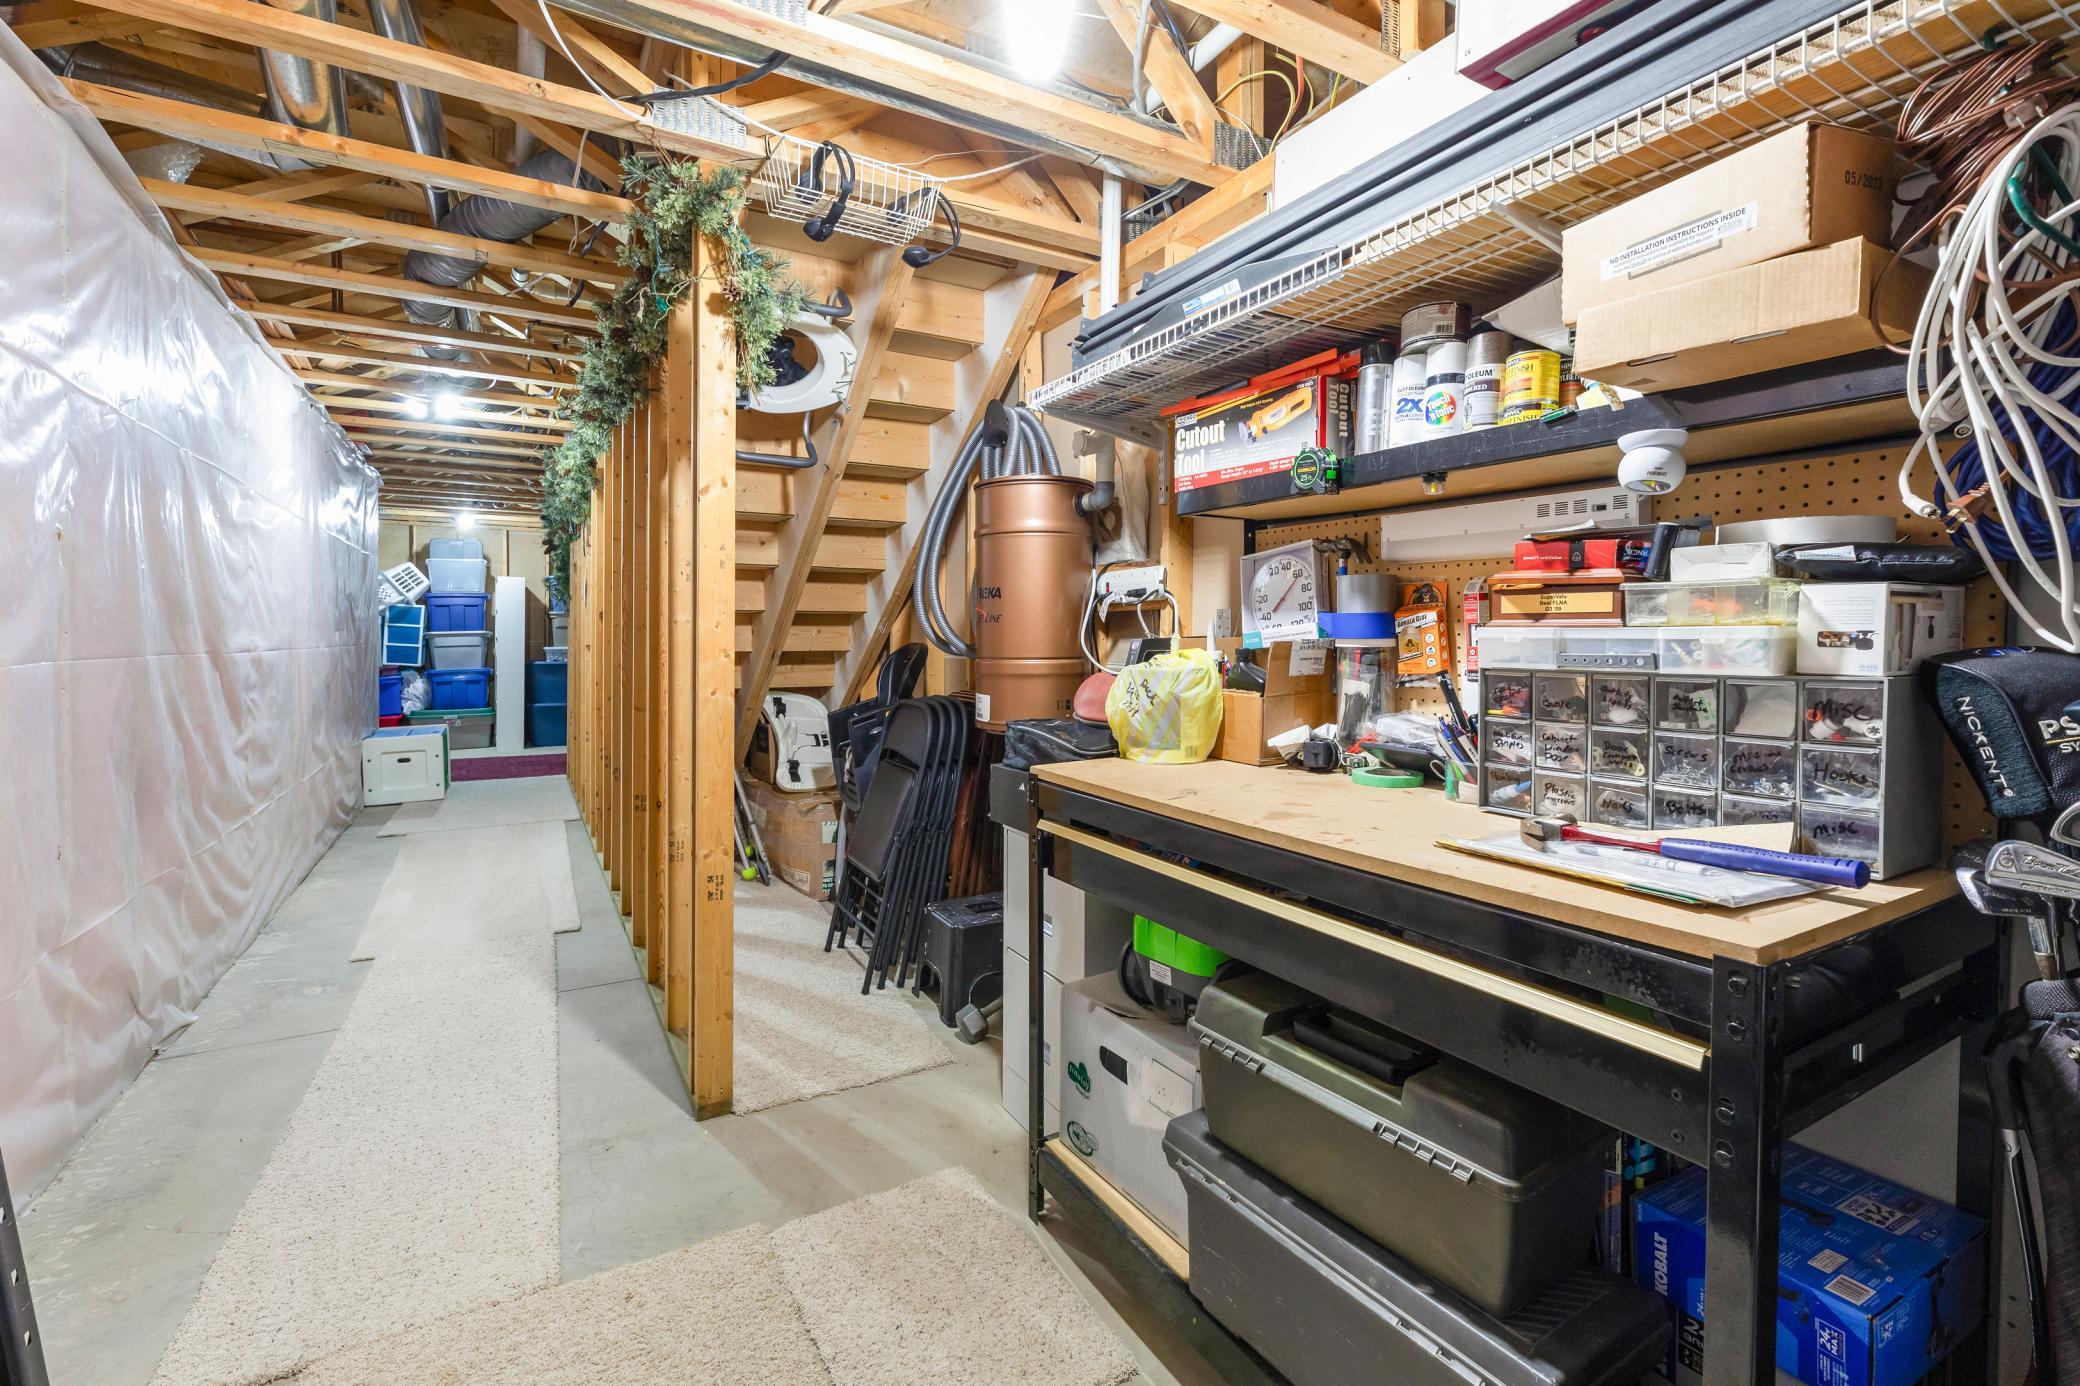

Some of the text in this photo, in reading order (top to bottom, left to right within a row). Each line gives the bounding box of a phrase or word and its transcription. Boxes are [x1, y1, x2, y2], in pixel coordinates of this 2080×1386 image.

[1609, 257, 1619, 266] NO
[1619, 238, 1665, 261] INSTALLATION
[1666, 218, 1719, 245] INSTRUCTIONS
[1720, 207, 1747, 223] INSIDE
[1328, 383, 1339, 415] Tool
[1396, 397, 1424, 415] 2X
[1338, 383, 1349, 437] Cutout
[1176, 419, 1226, 452] Cutout
[1176, 449, 1205, 476] Tool
[1269, 566, 1279, 576] 20
[1281, 561, 1291, 571] 40
[1292, 568, 1303, 579] 60
[1301, 582, 1312, 593] 80
[1256, 594, 1268, 604] -20
[1298, 601, 1313, 612] 100
[1542, 699, 1572, 710] Cable
[1957, 696, 2009, 788] NICKENT
[1664, 744, 1708, 762] Screws
[1814, 762, 1868, 785] Hooks
[1653, 1231, 1668, 1296] KOBALT
